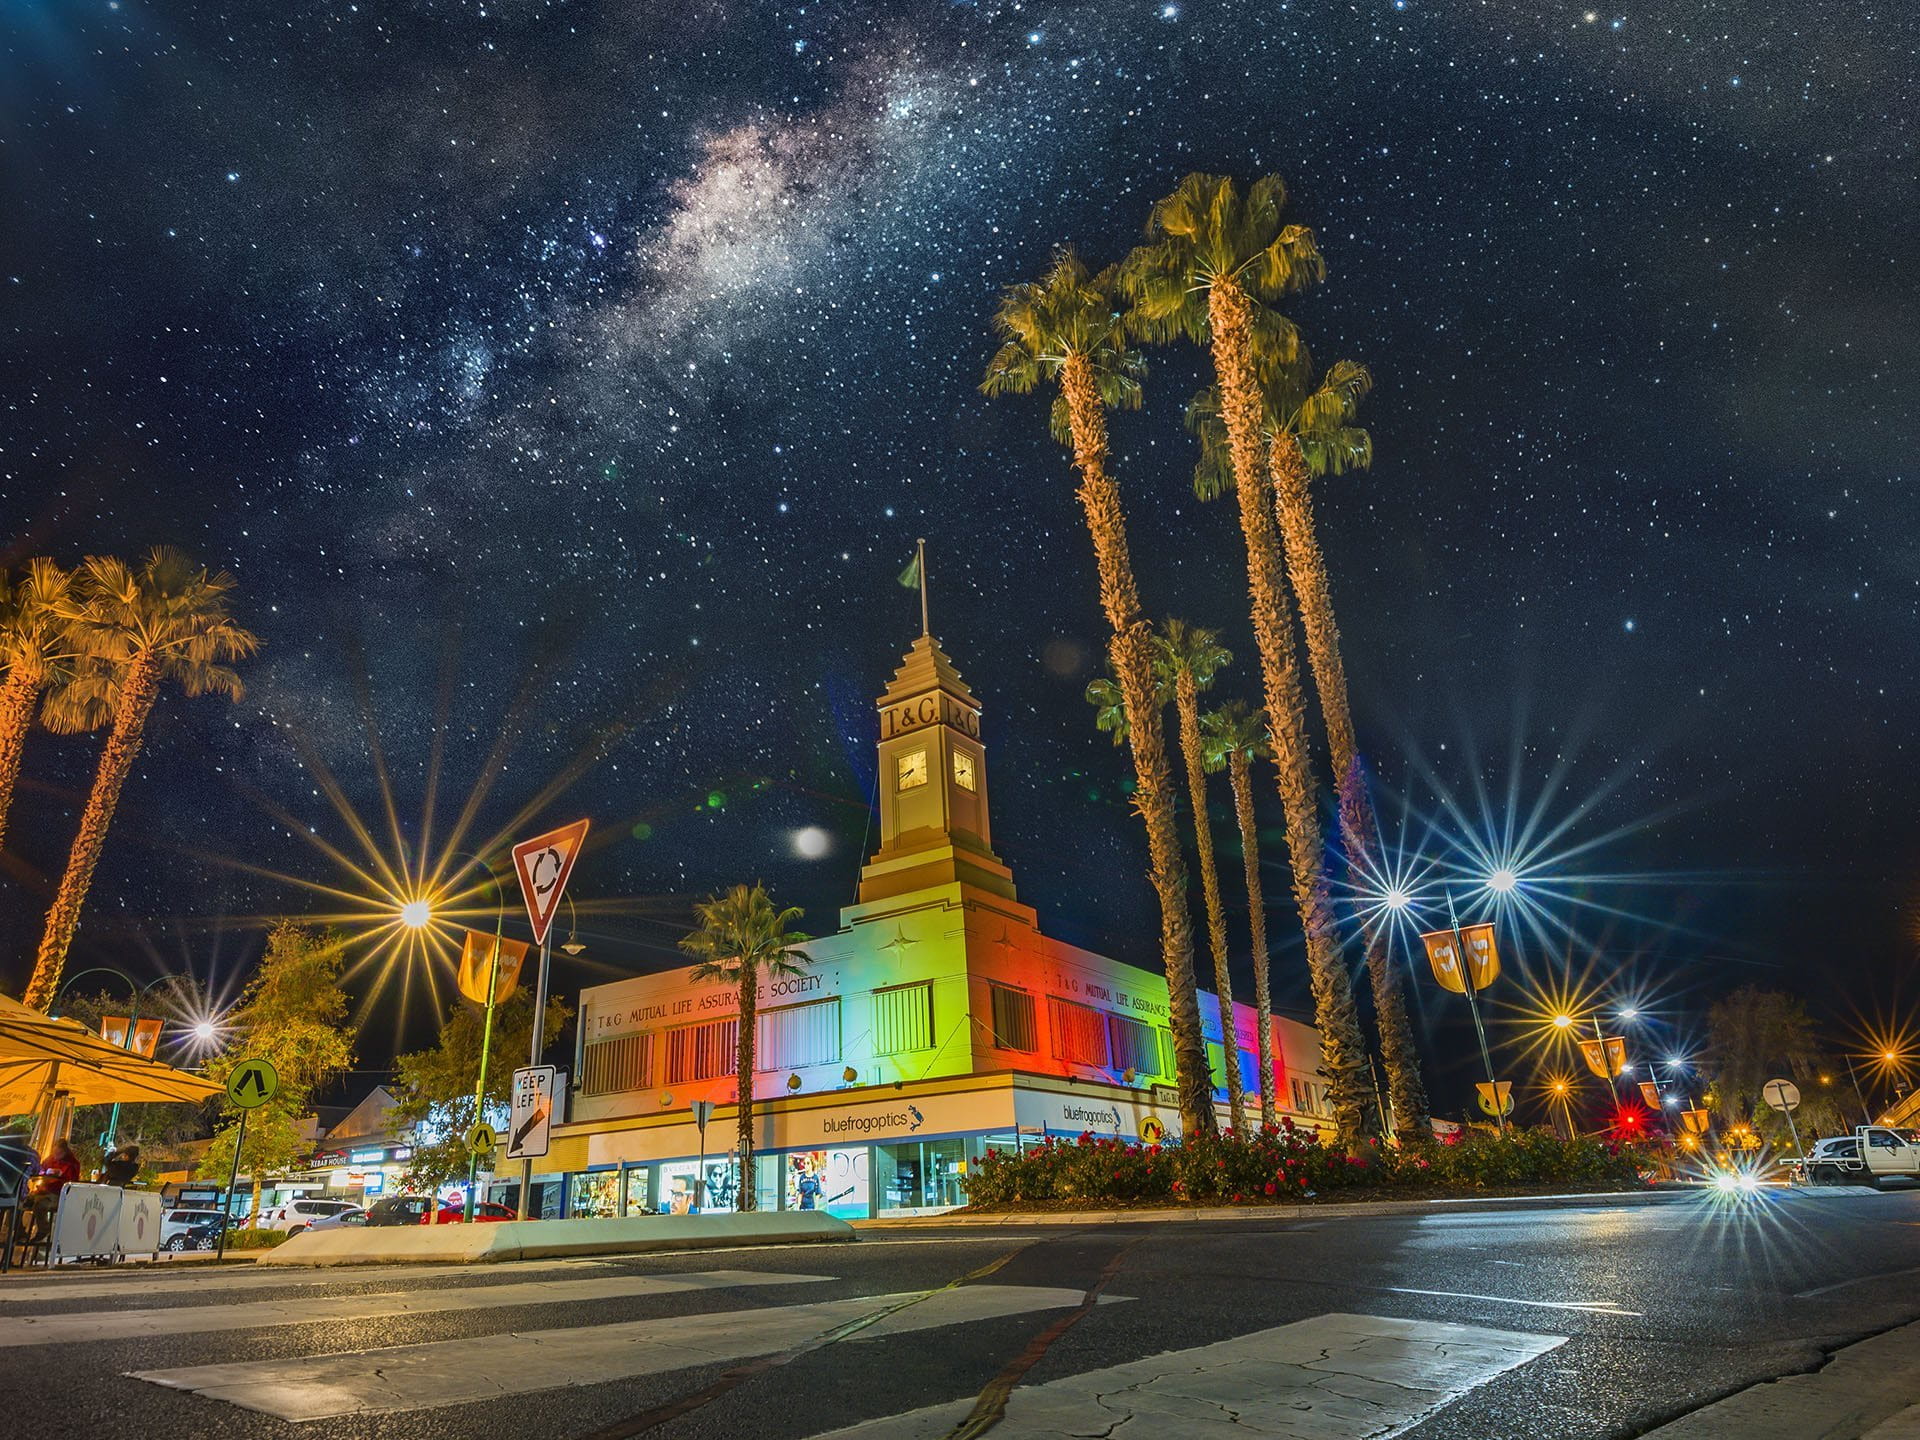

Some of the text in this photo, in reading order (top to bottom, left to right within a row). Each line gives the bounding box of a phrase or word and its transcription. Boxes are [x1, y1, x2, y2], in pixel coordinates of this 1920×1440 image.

[629, 1002, 667, 1023] MUTUAL
[672, 1000, 692, 1016] LIFE
[700, 986, 765, 1009] ASSURAE
[771, 974, 824, 998] SOCIETY
[1085, 983, 1112, 1002] MUTUAL
[1115, 991, 1129, 1007] LIFE
[1132, 996, 1167, 1018] ASSURANCE
[518, 1074, 546, 1089] KEEP
[517, 1092, 543, 1109] LEFT
[823, 1112, 908, 1133] bluefrogoptics
[1063, 1105, 1114, 1126] bluefrogoptics
[310, 1159, 329, 1168] KEBAB
[329, 1156, 347, 1166] HOUSE
